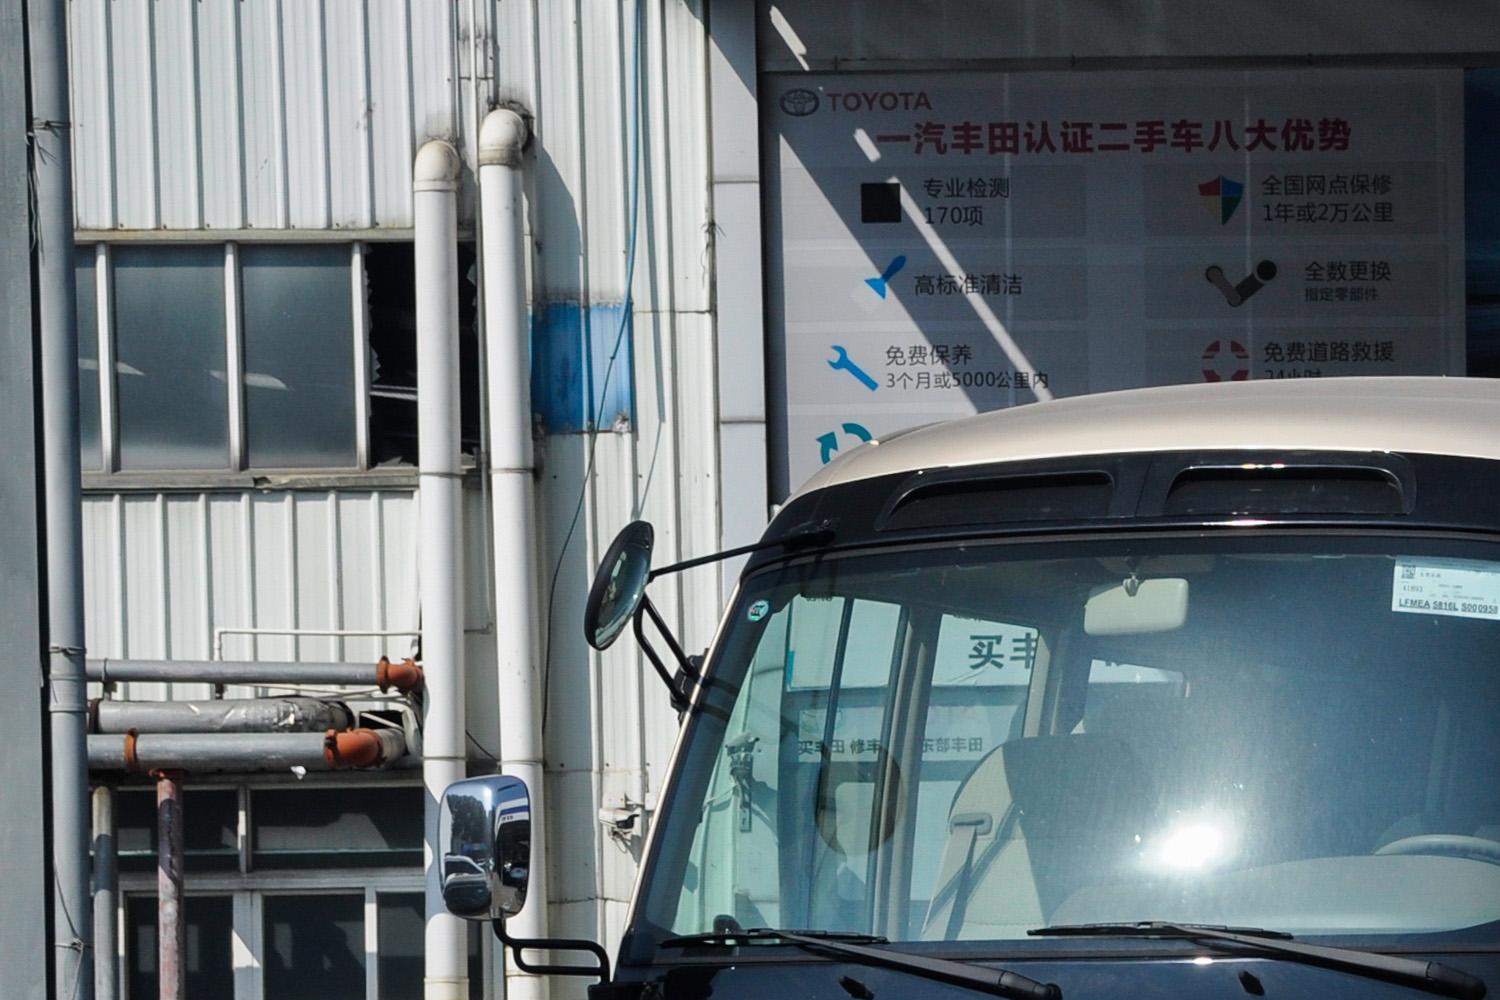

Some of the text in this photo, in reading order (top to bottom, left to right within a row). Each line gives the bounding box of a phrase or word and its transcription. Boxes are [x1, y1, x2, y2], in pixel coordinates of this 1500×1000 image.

[827, 91, 933, 112] TOYOTA
[876, 117, 1352, 155] 一汽丰田认证二手车八大优势
[923, 177, 1011, 200] 专业检测
[1262, 174, 1393, 196] 全国网点保修
[924, 206, 984, 226] 170项
[1262, 202, 1394, 223] 1年或2万公里
[1304, 260, 1392, 282] 全数更换
[914, 274, 1023, 296] 高标准清洁
[885, 344, 973, 367] 免费保养
[1264, 341, 1396, 363] 免费道路救援
[886, 370, 1049, 390] 3个月或5000公里内
